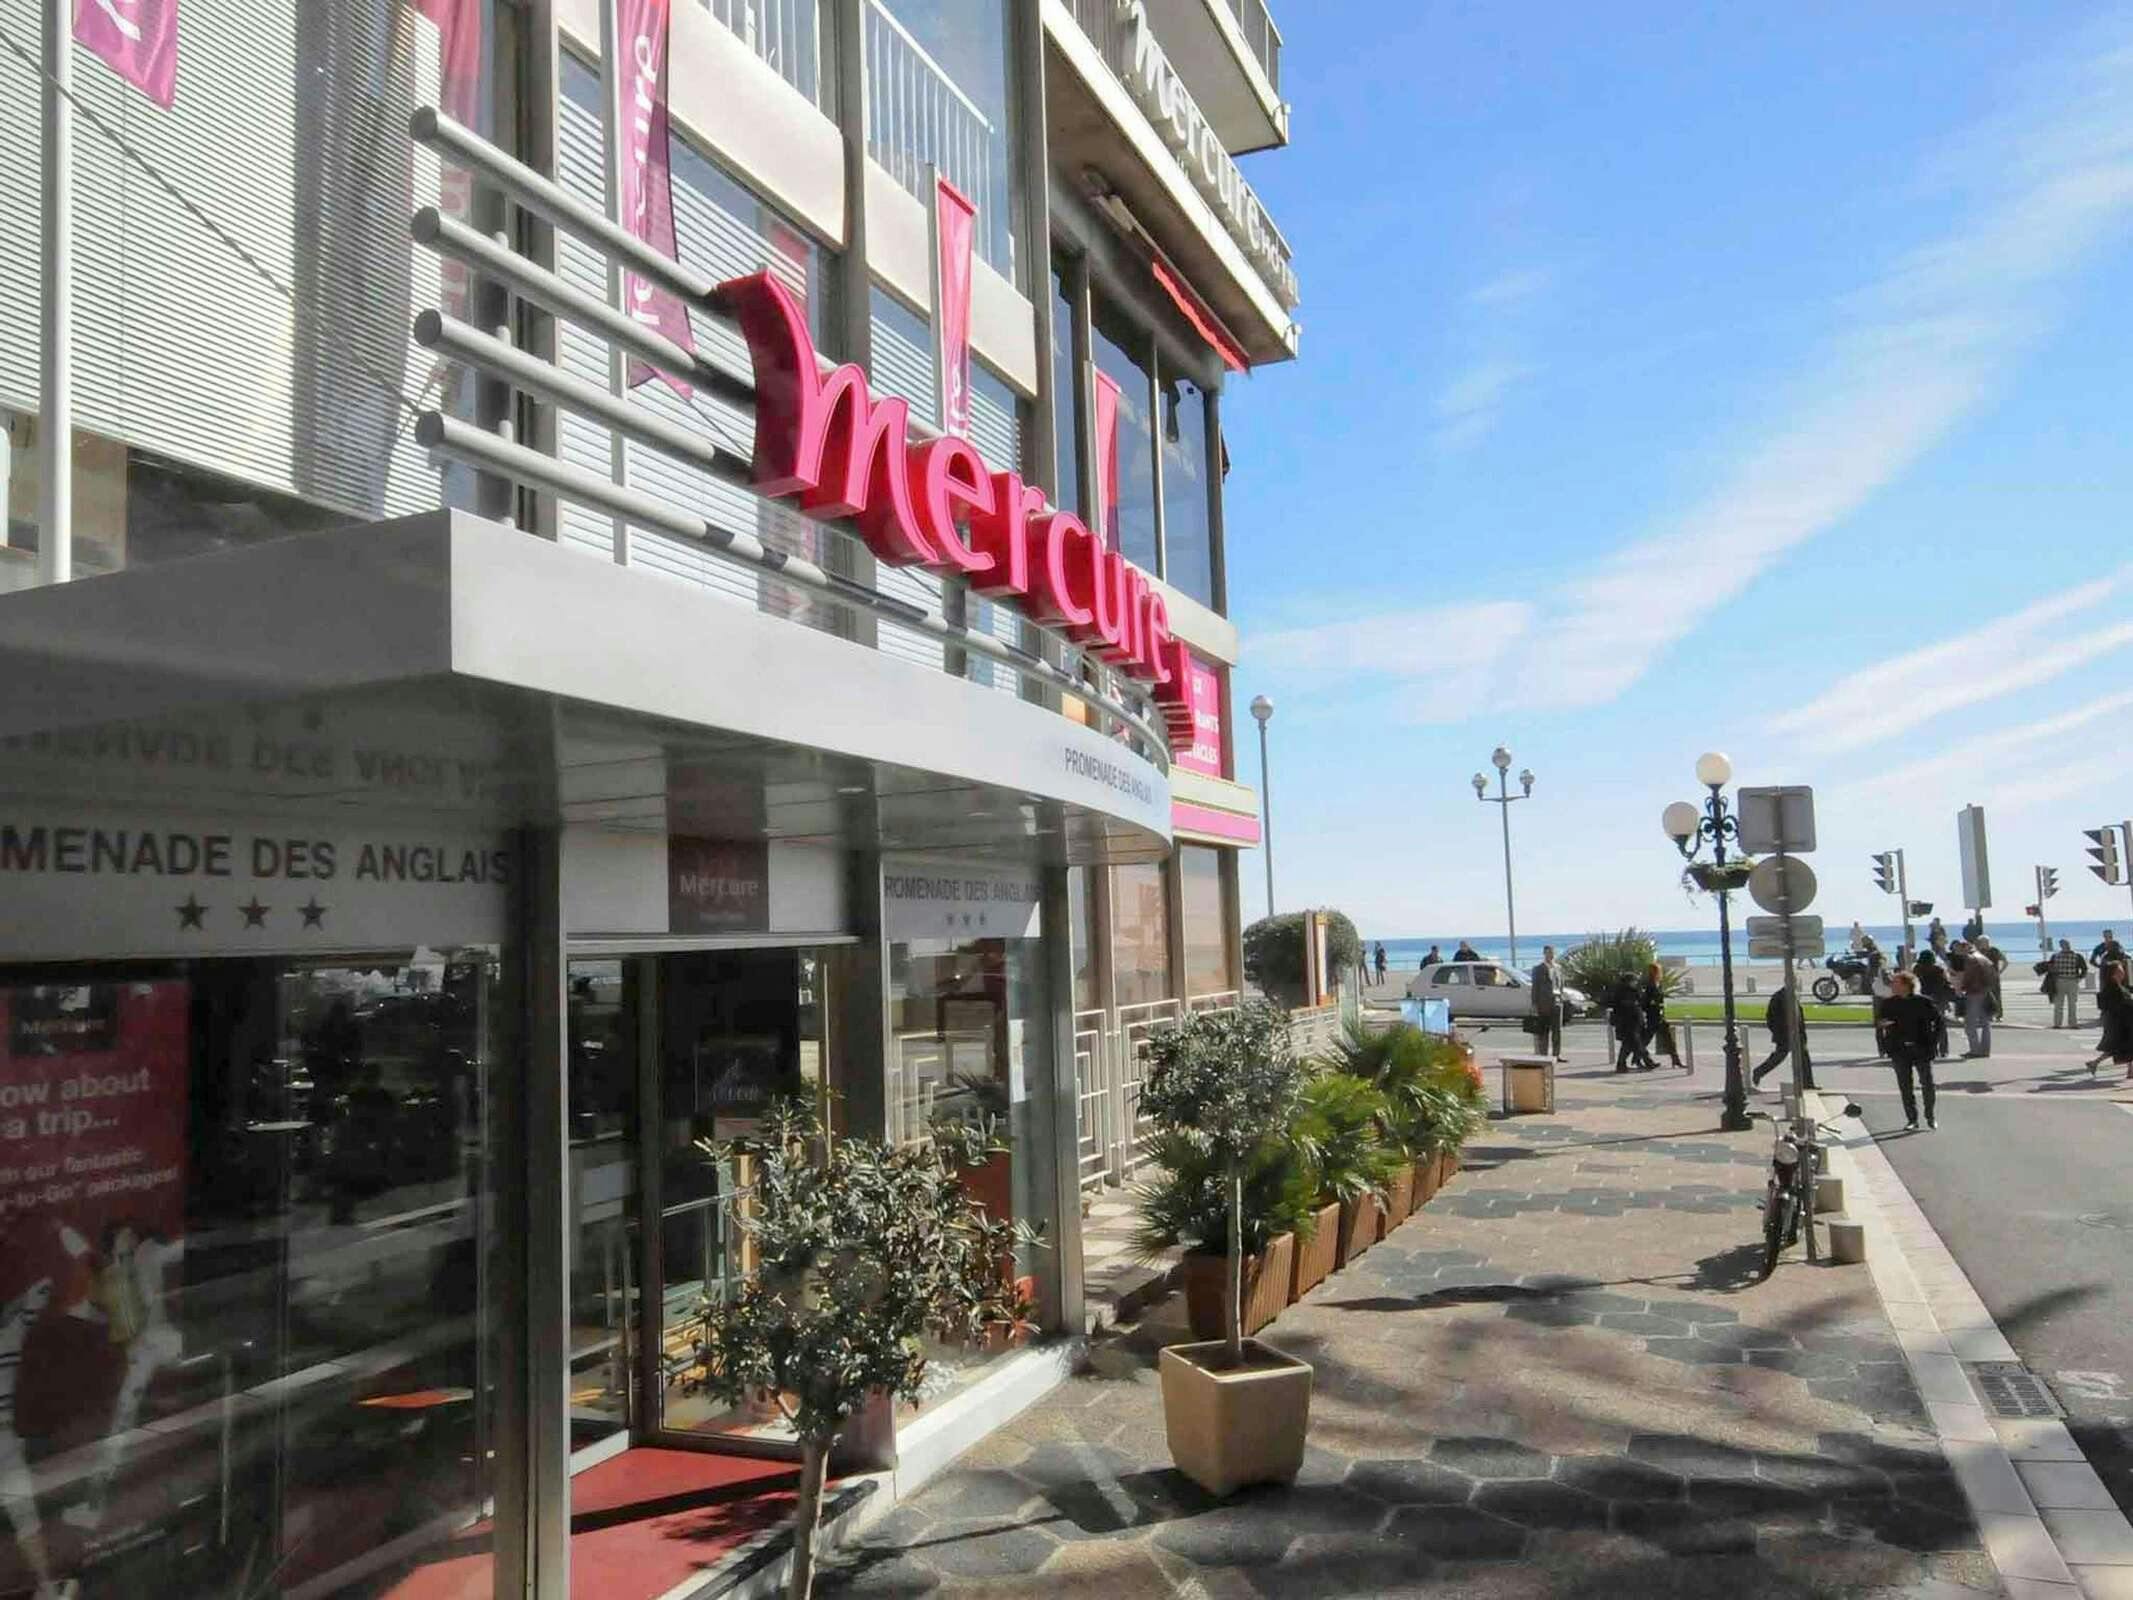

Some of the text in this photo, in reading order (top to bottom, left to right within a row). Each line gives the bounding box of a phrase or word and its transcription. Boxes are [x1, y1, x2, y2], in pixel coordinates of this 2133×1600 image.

[251, 837, 337, 879] DES
[355, 843, 512, 884] ANGLAIS
[884, 876, 960, 901] ROMENADE
[61, 1066, 151, 1101] about
[4, 1116, 26, 1139] a
